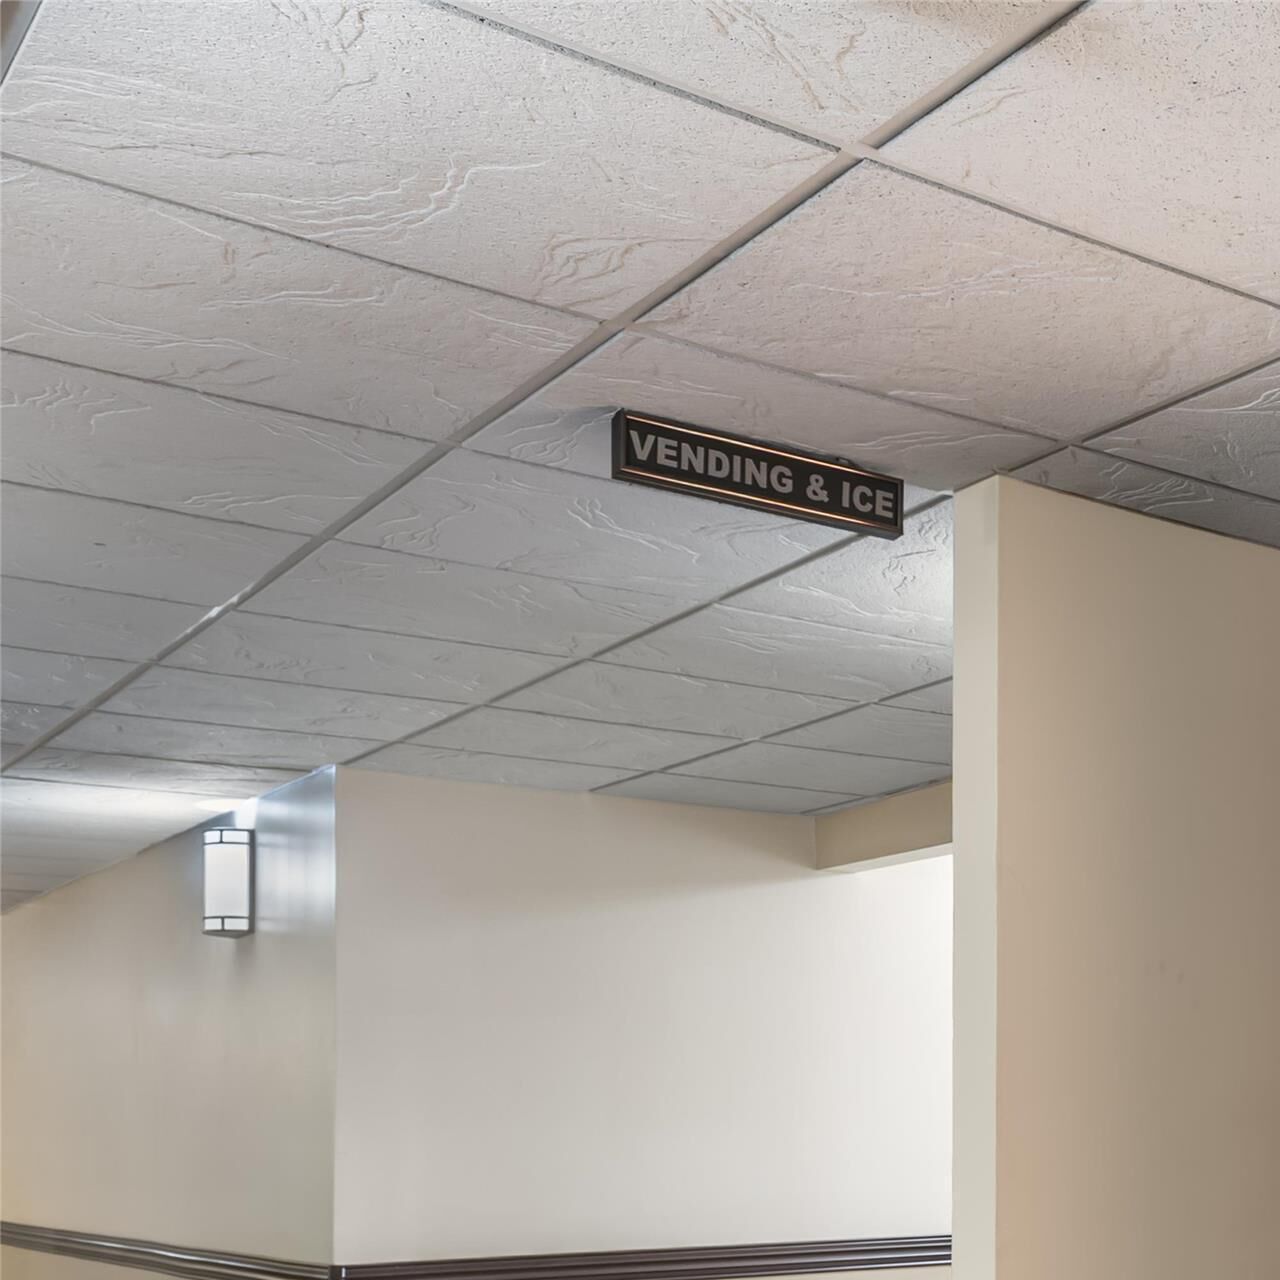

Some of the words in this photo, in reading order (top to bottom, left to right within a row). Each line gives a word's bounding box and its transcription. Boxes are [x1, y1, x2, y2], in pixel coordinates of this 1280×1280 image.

[628, 429, 794, 494] VENDING
[806, 474, 830, 502] &
[841, 481, 895, 518] ICE
